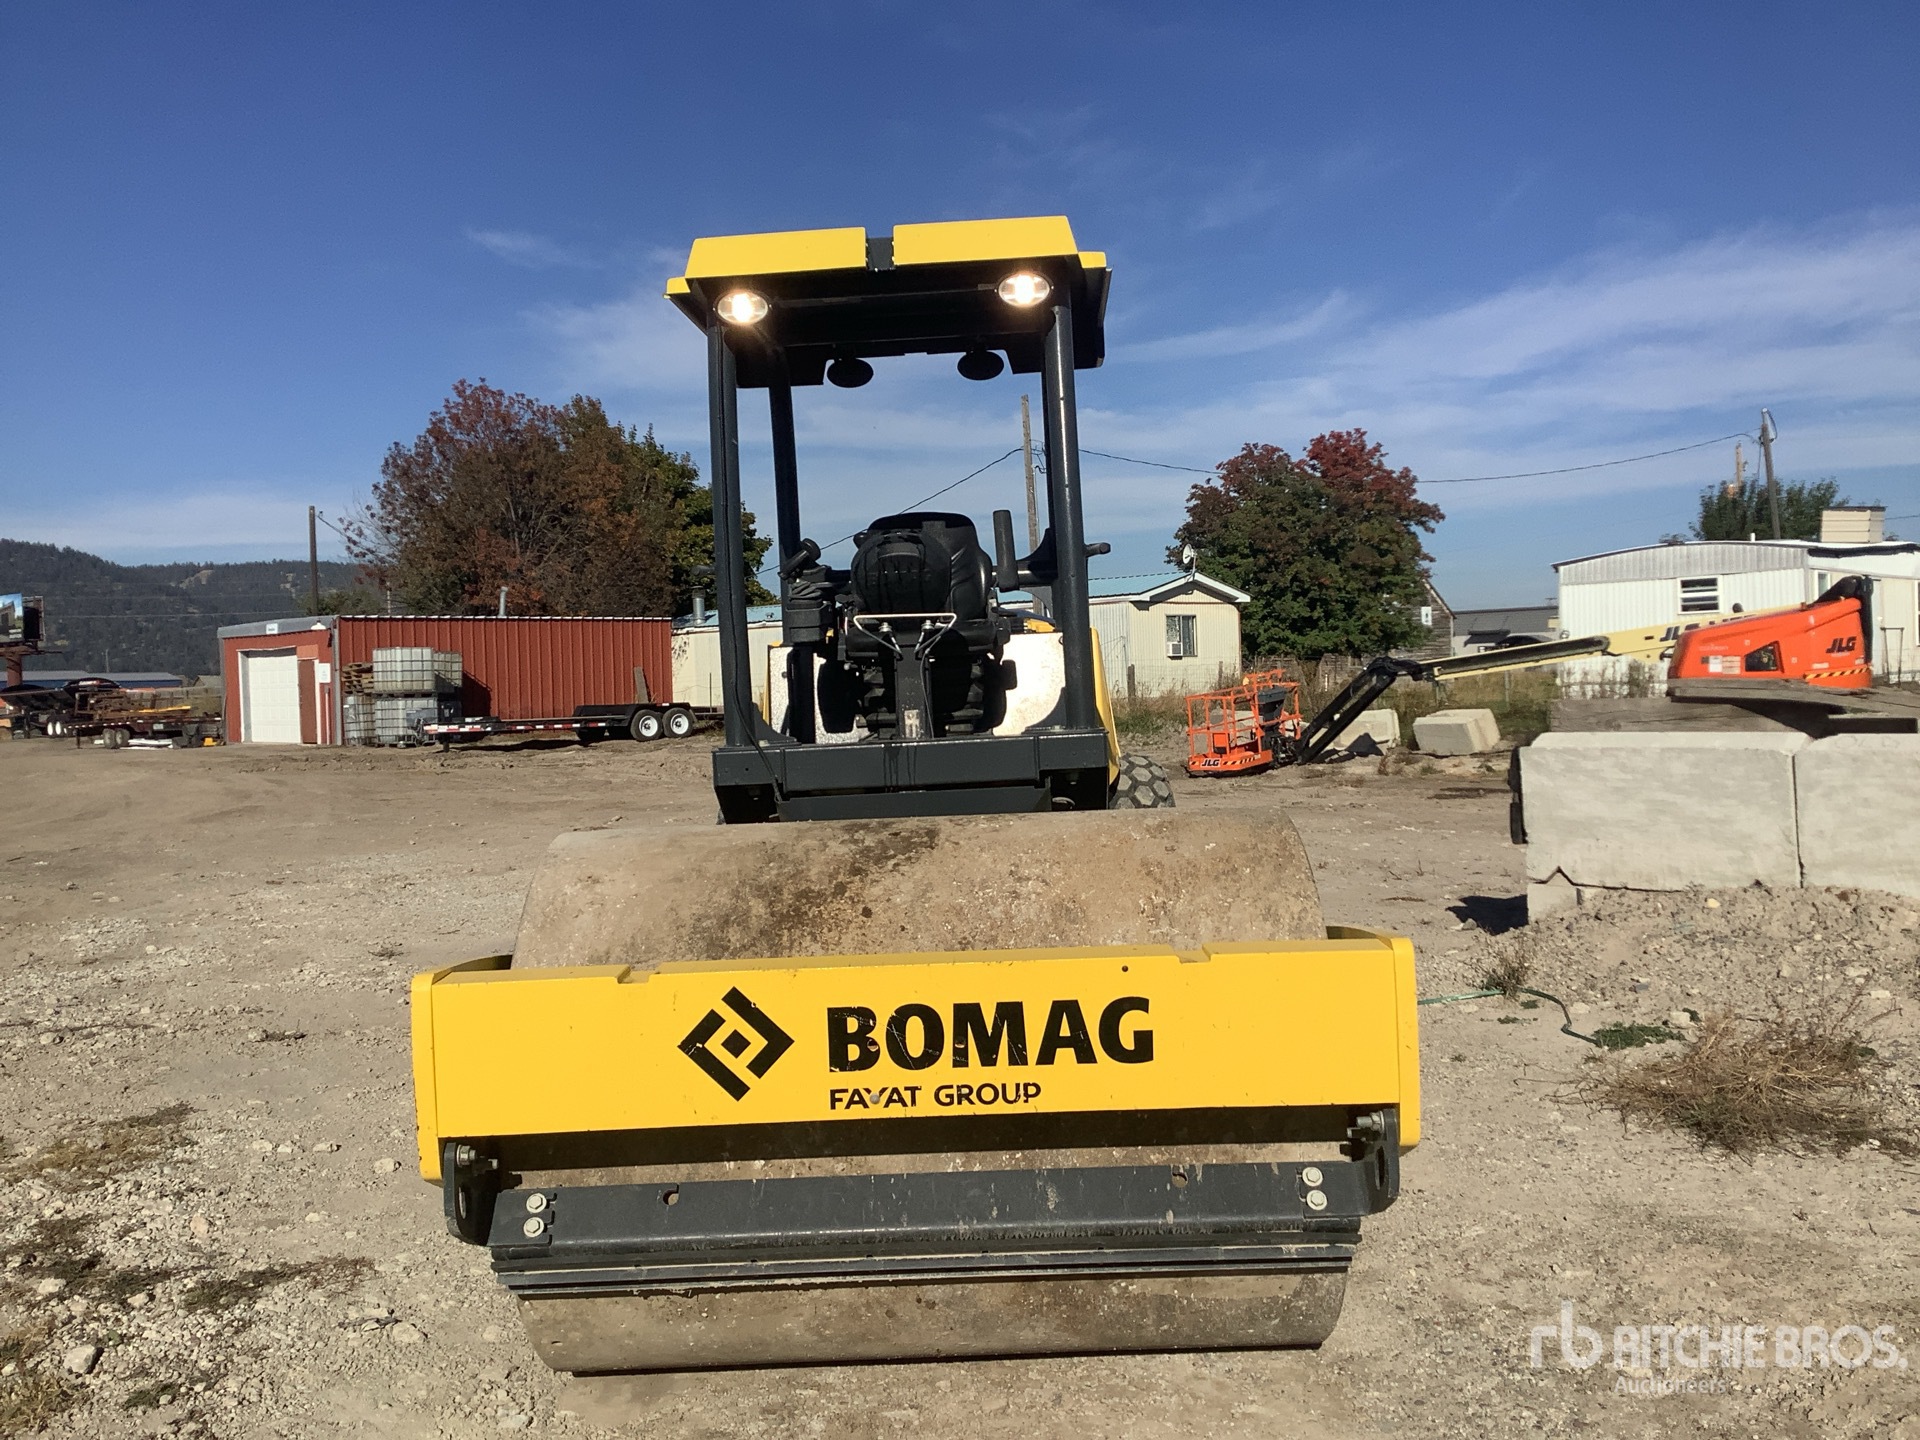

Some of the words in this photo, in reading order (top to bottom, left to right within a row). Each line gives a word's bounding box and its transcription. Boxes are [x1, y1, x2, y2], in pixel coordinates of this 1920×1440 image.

[1825, 636, 1857, 654] JLG
[1201, 759, 1220, 767] JLG
[827, 996, 1154, 1072] BOMAG
[934, 1082, 1041, 1106] GROUP
